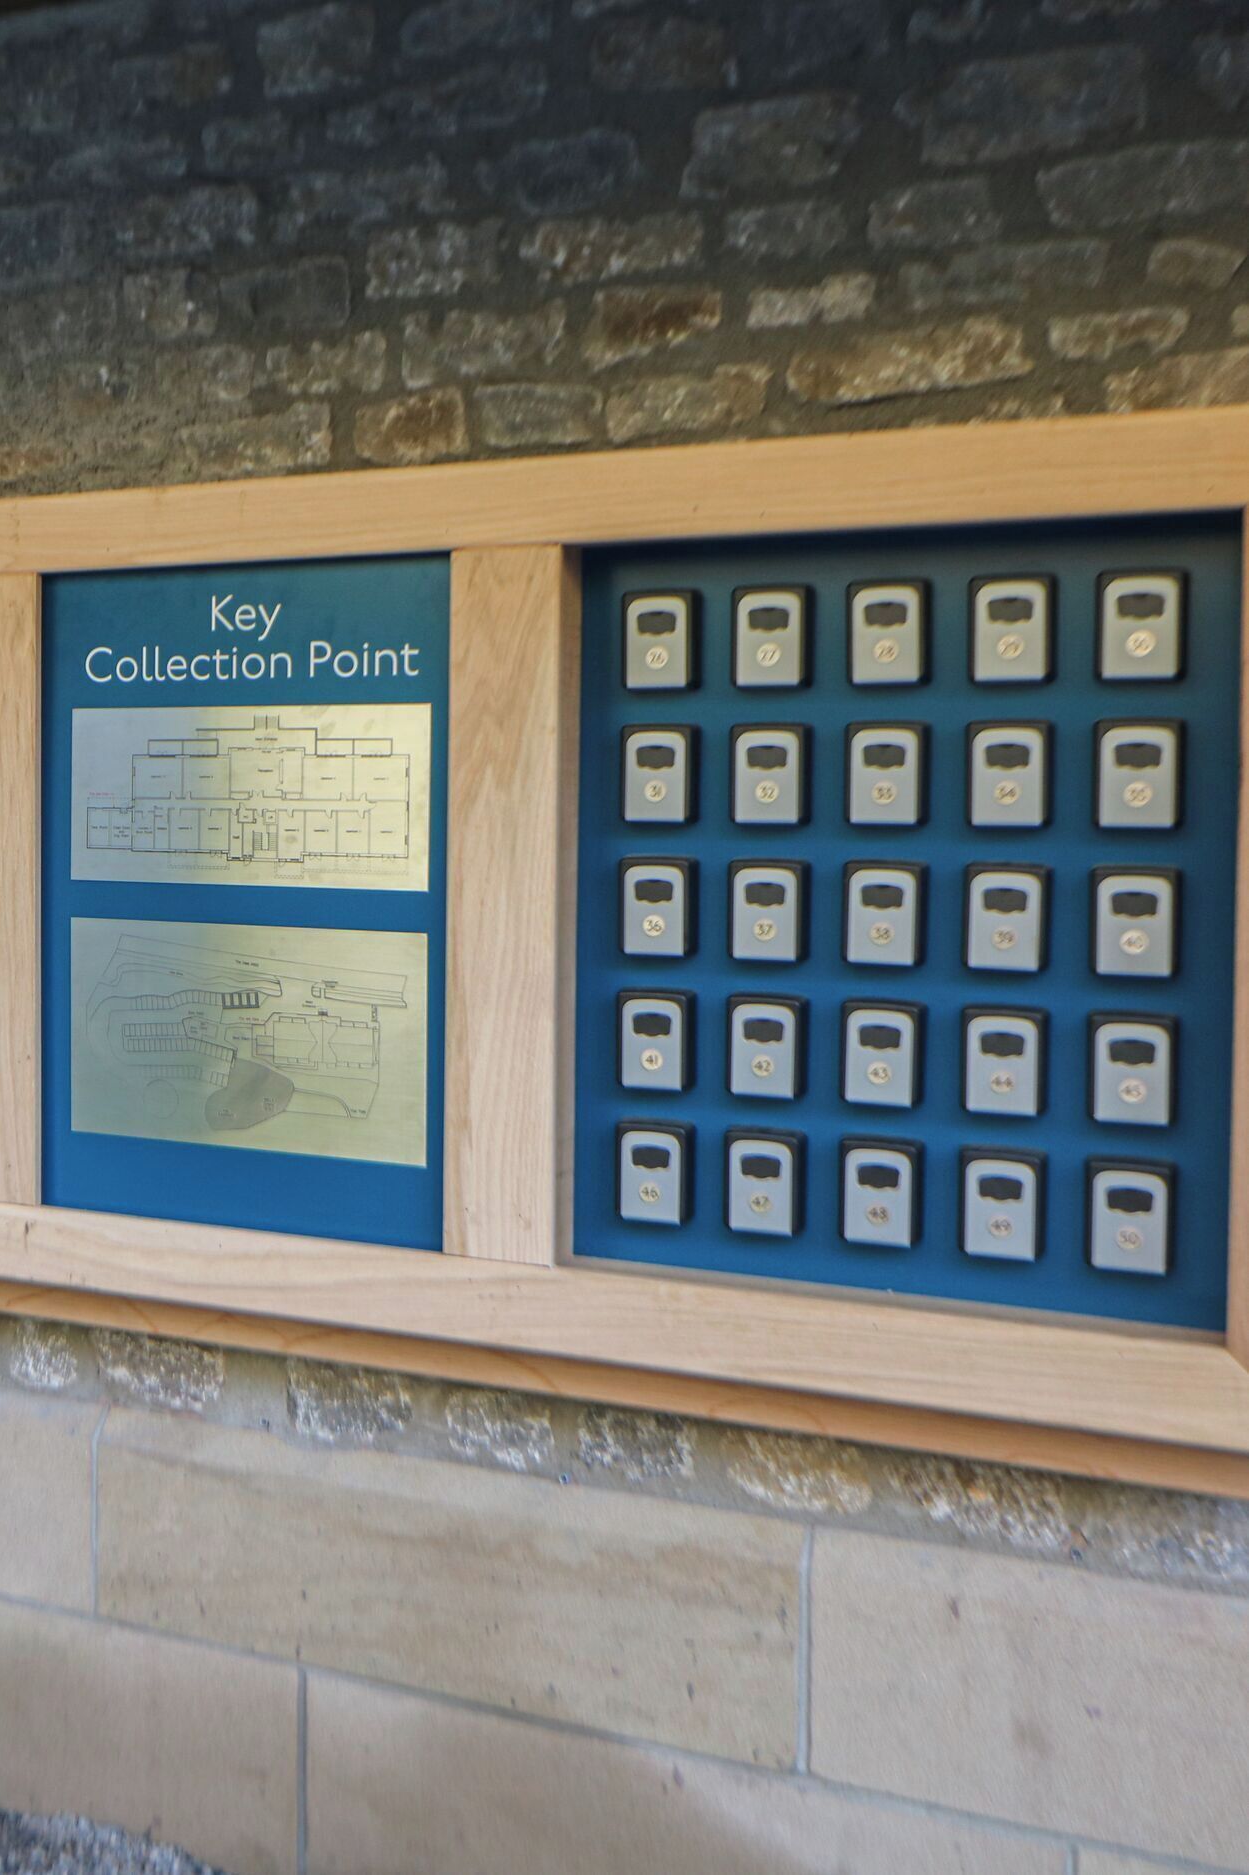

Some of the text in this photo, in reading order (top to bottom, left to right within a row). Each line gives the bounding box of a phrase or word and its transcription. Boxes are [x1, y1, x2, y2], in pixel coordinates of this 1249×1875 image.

[210, 593, 282, 641] Key
[84, 640, 420, 683] Collection Point
[650, 785, 662, 797] 31
[760, 786, 776, 799] 32
[875, 786, 893, 799] 33
[646, 918, 662, 932] 36
[757, 923, 772, 936] 37
[645, 1054, 658, 1066] 41
[753, 1059, 771, 1073] 42
[869, 1066, 888, 1080] 43
[991, 1075, 1014, 1088] 44
[1120, 1084, 1142, 1098] 45
[641, 1186, 659, 1200] 46
[751, 1195, 769, 1207] 47
[868, 1206, 888, 1222] 48
[991, 1219, 1012, 1233] 49
